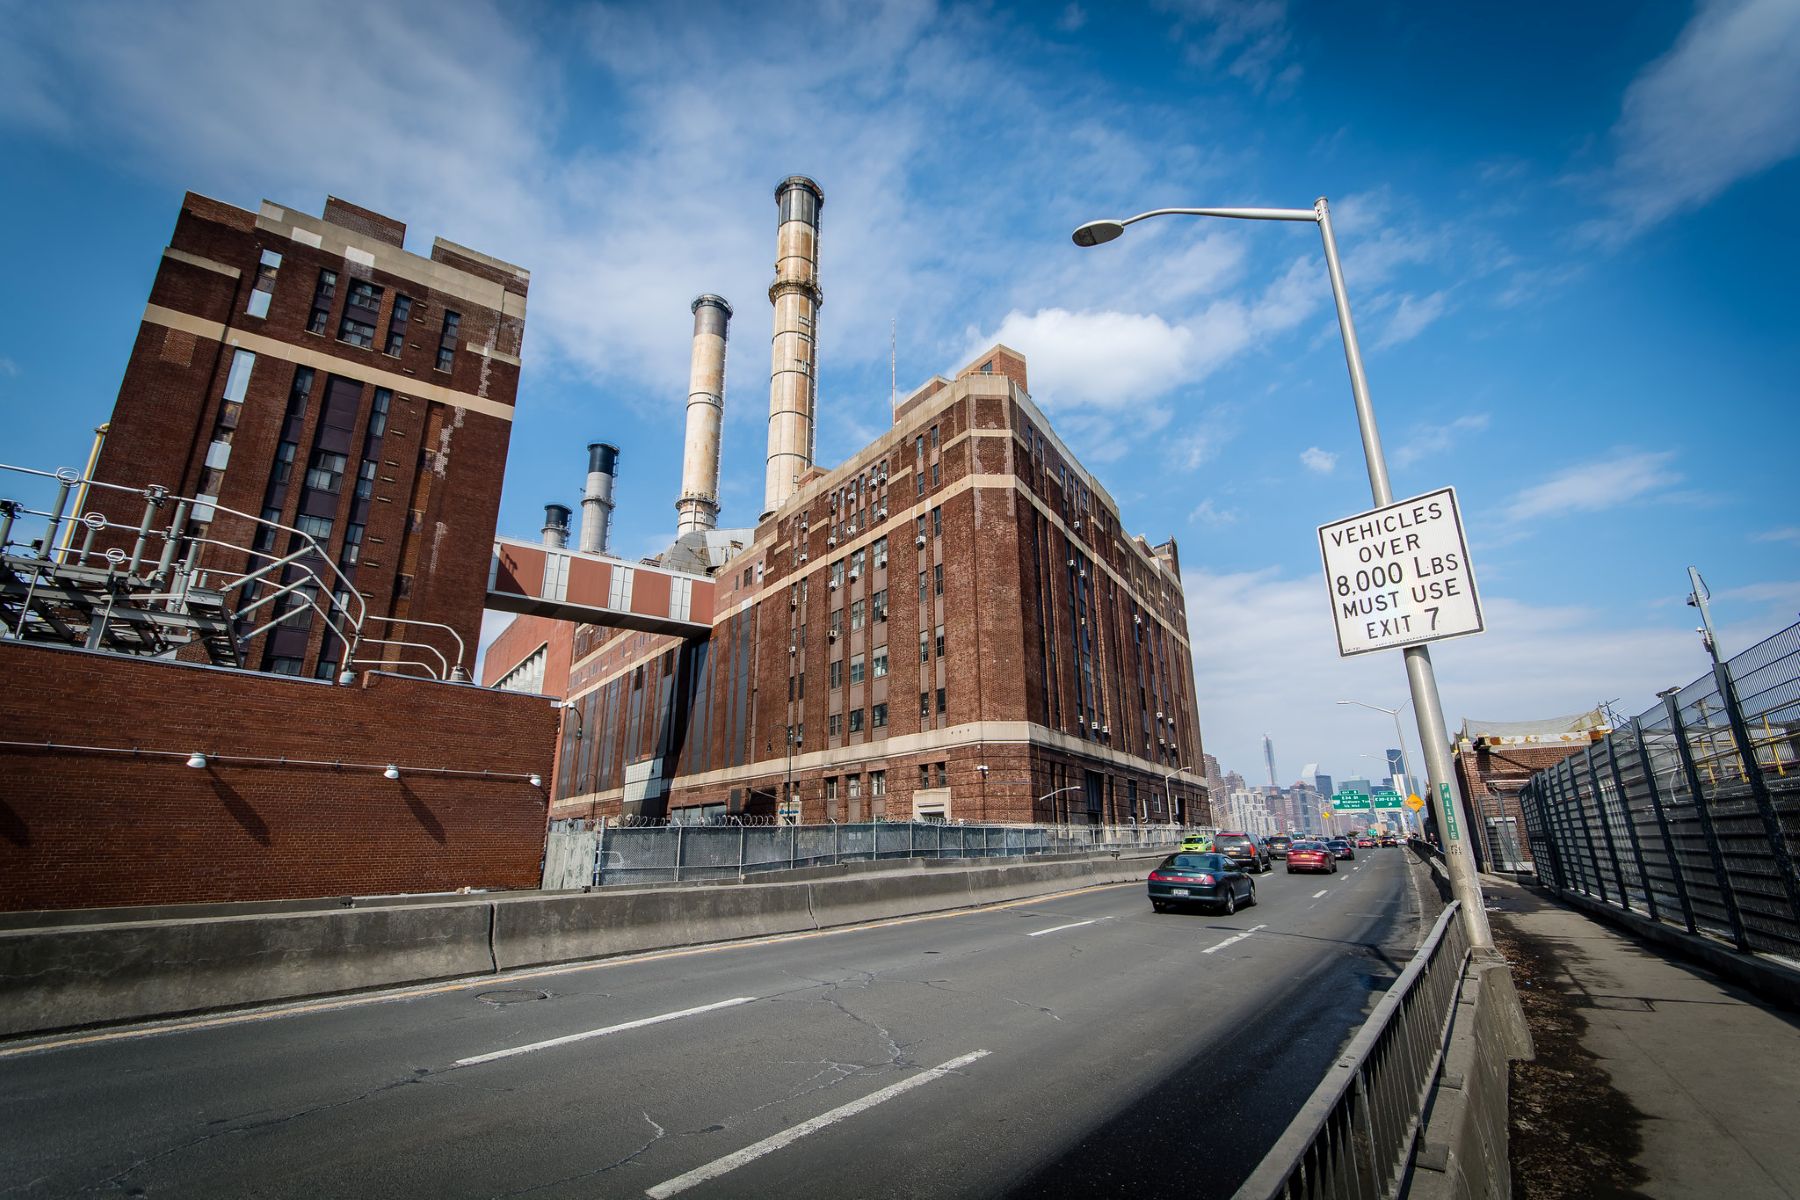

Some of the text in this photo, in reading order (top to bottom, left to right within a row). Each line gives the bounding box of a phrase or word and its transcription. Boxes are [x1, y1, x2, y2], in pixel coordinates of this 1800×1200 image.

[1331, 503, 1442, 547] VEHICLES
[1359, 533, 1421, 563] OVER
[1336, 553, 1459, 597] 8,000 LBS
[1342, 578, 1461, 619] MUST USE
[1366, 606, 1439, 640] EXIT 7
